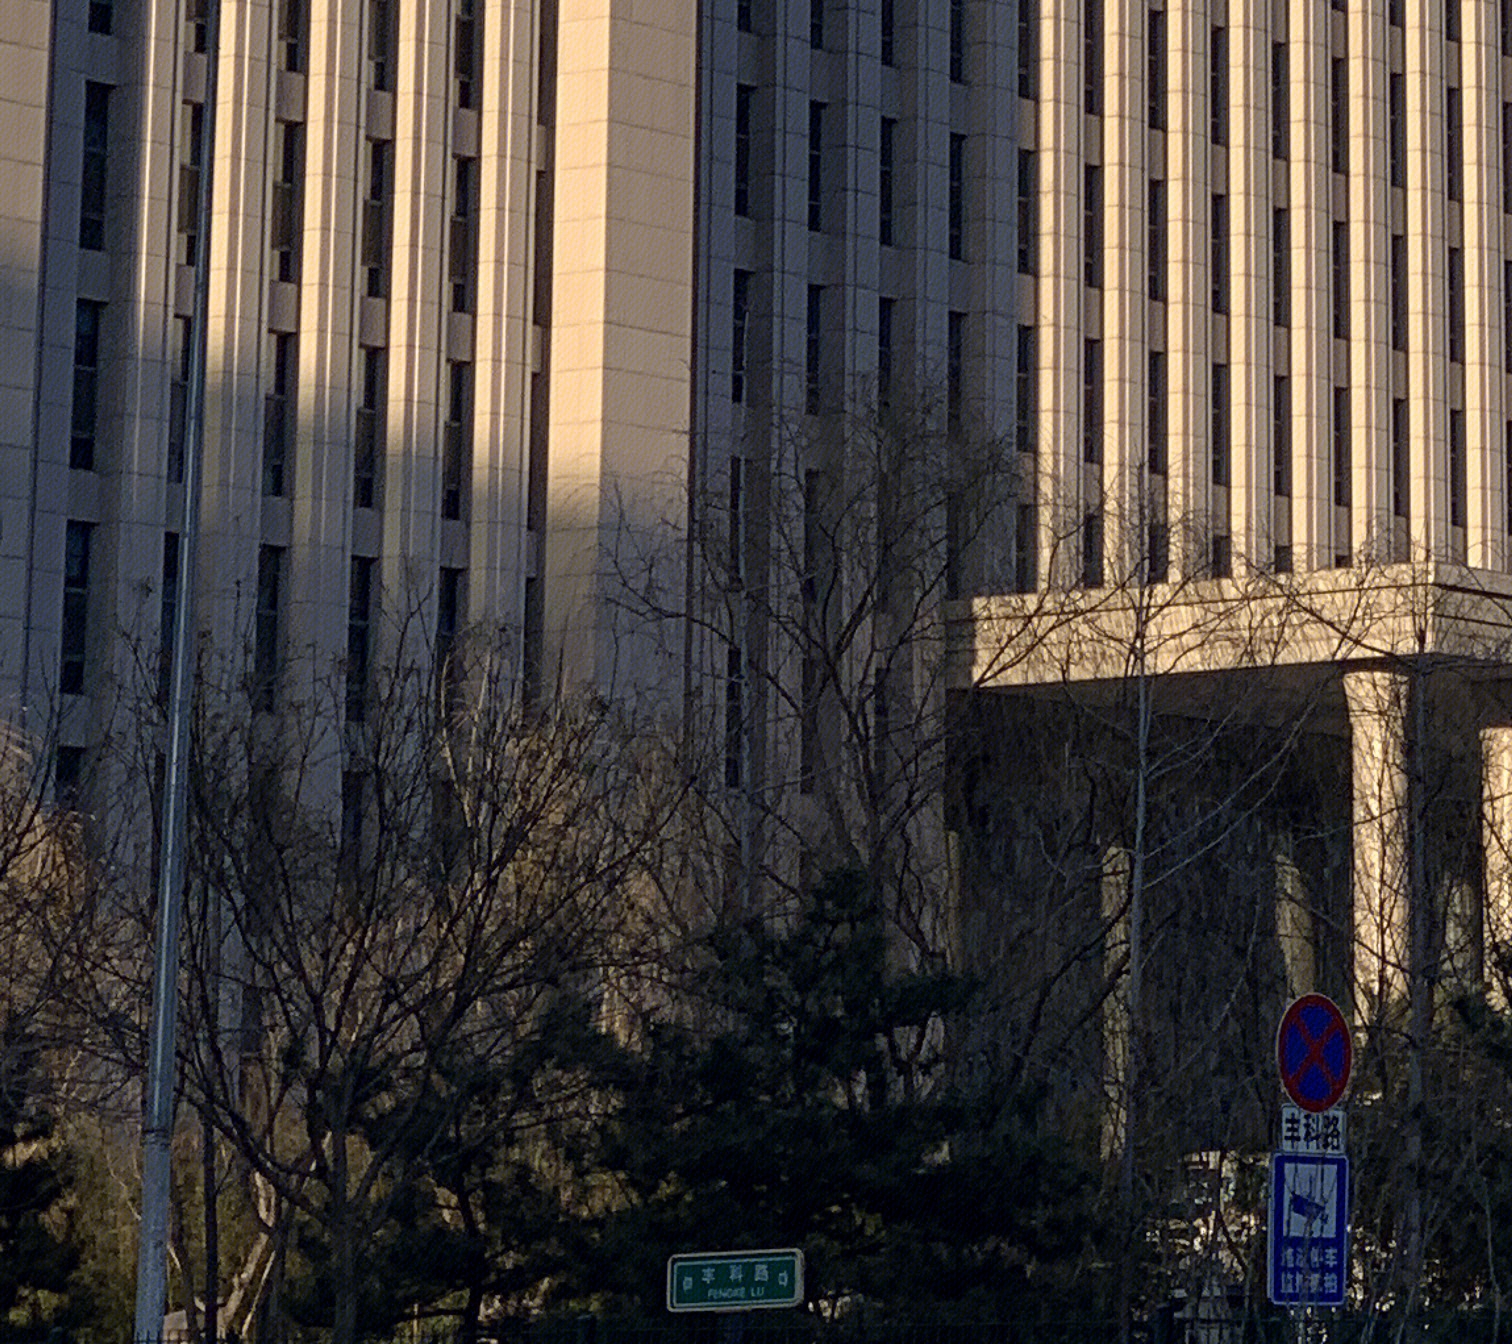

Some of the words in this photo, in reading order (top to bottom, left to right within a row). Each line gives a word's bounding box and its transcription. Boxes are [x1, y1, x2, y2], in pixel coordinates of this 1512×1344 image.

[1284, 1113, 1340, 1150] 丰科路
[750, 1286, 765, 1298] LU
